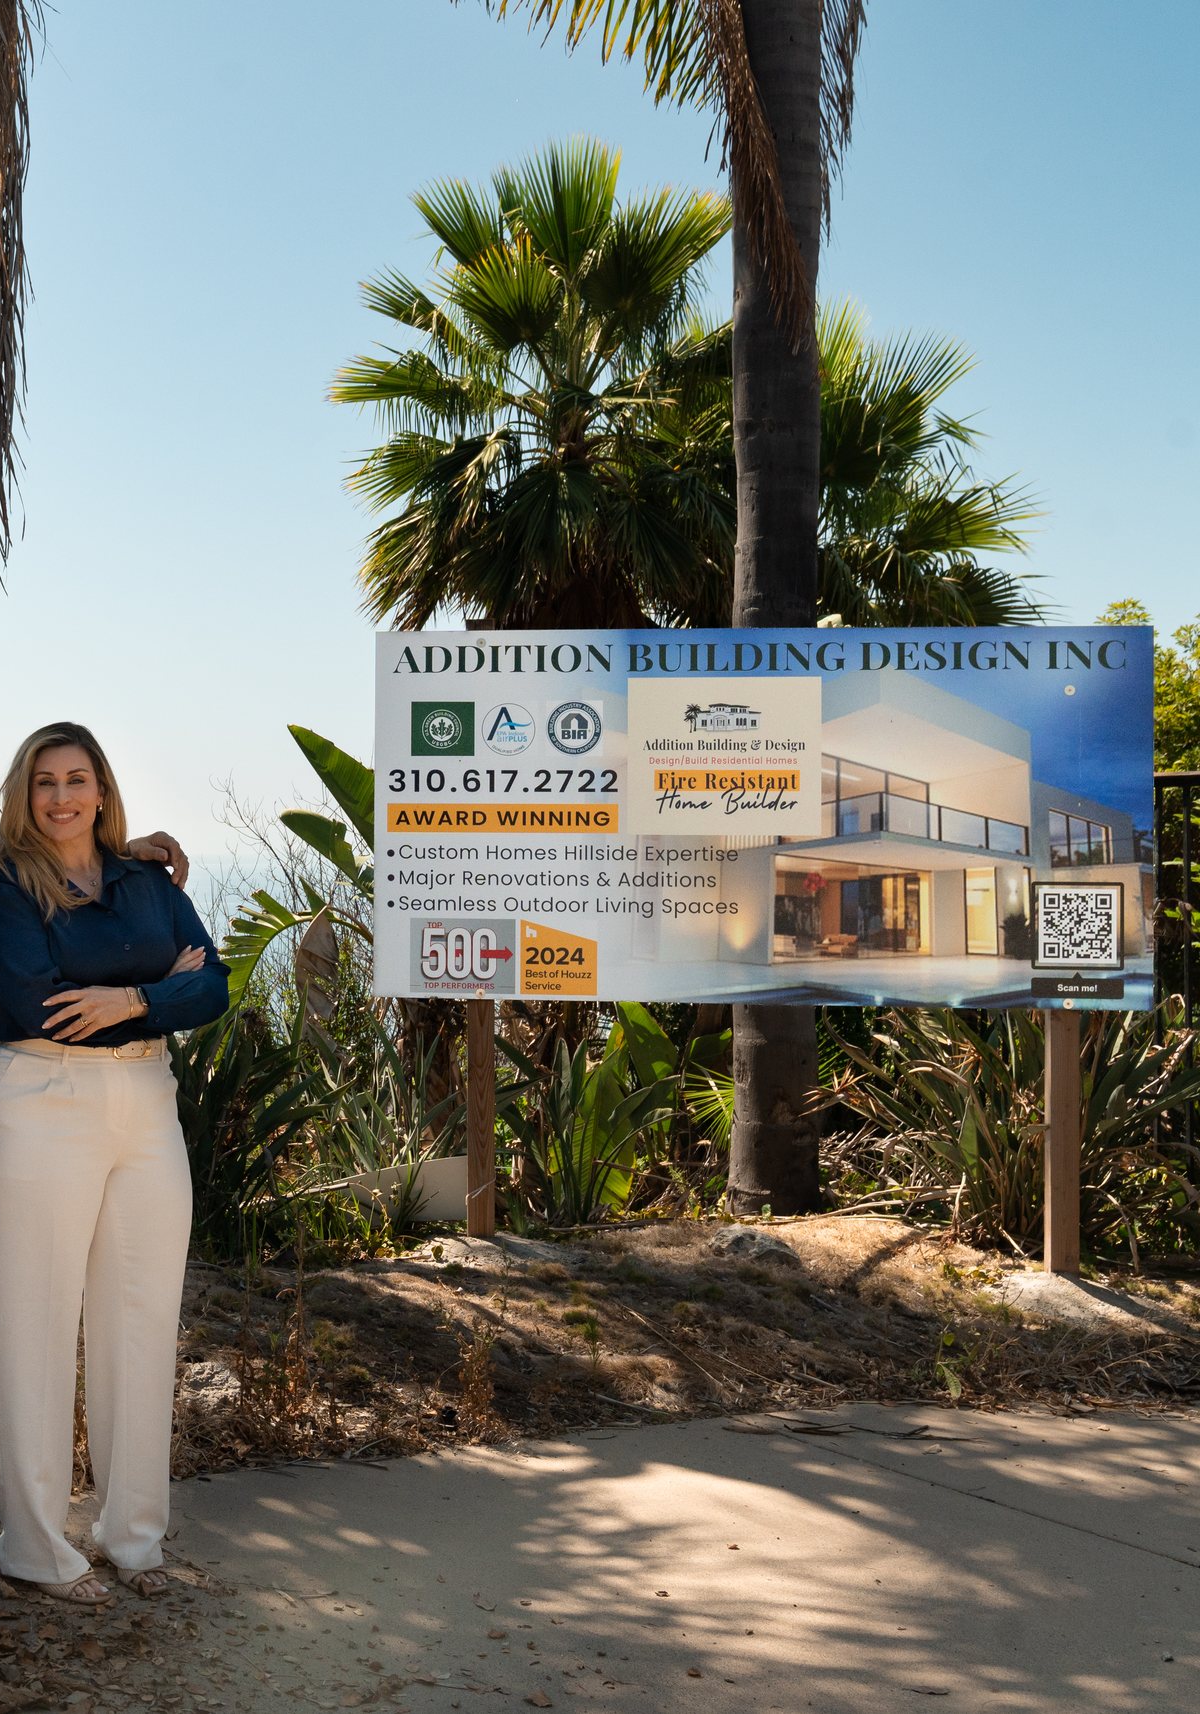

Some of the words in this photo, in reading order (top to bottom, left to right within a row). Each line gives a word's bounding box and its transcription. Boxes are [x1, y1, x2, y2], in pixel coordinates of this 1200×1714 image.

[393, 643, 614, 673] ADDITION
[626, 641, 846, 672] BUILDING
[860, 640, 1030, 670] DESIGN
[1046, 639, 1127, 670] INC
[561, 729, 588, 740] BIA
[643, 739, 694, 751] Addition
[697, 739, 748, 753] Building
[750, 739, 762, 751] &
[765, 739, 806, 753] Design
[649, 756, 708, 766] Design/Build
[711, 756, 763, 765] Residential
[766, 757, 798, 765] Homes
[388, 769, 619, 793] 310.617.2722
[658, 772, 697, 790] Fire
[705, 772, 797, 790] Resistant
[656, 785, 712, 814] Home
[721, 784, 799, 815] Builder
[395, 811, 488, 826] AWARD
[497, 810, 611, 827] WINNING
[398, 844, 479, 861] Custom
[486, 845, 558, 862] Homes
[564, 845, 638, 863] Hillside
[645, 845, 739, 866] Expertise
[399, 869, 456, 889] Major
[462, 870, 590, 887] Renovations
[597, 871, 611, 888] &
[618, 871, 717, 889] Additions
[398, 895, 497, 912] Seamless
[504, 896, 589, 913] Outdoor
[596, 897, 654, 919] Living
[662, 898, 739, 919] Spaces
[427, 921, 443, 929] TOP
[421, 927, 497, 981] 500
[525, 947, 585, 966] 2024
[525, 970, 548, 979] Best
[549, 970, 560, 979] of
[561, 970, 592, 979] Houzz
[441, 982, 495, 990] PERFORMERS
[525, 981, 562, 991] Service
[1057, 983, 1079, 992] Scan
[1081, 984, 1098, 992] me!
